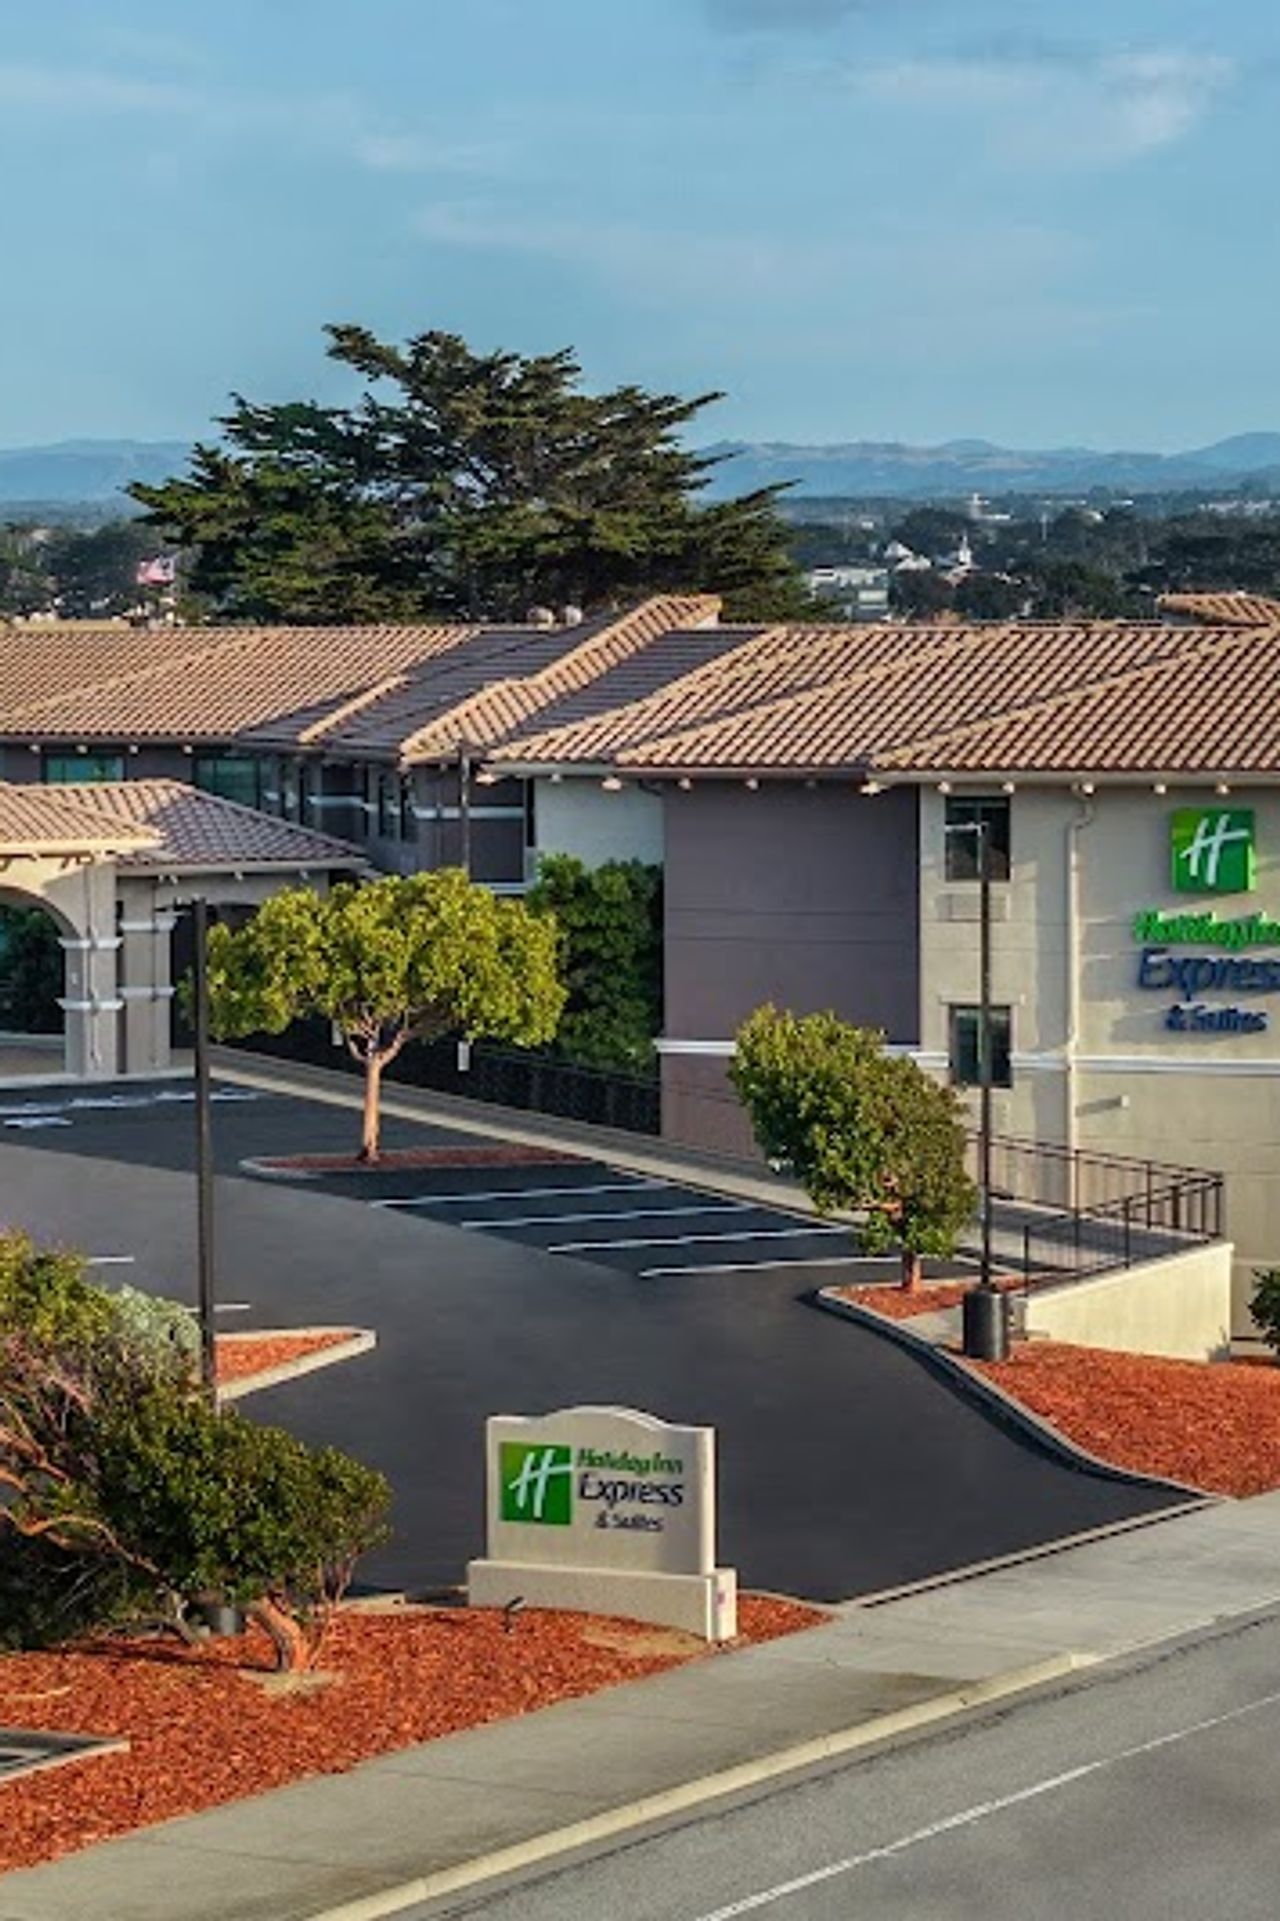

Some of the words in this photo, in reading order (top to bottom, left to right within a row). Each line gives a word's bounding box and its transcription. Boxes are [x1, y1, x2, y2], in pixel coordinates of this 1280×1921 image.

[1251, 911, 1280, 945] In
[1140, 947, 1280, 1002] Expres
[1165, 1004, 1187, 1032] &
[1190, 1005, 1268, 1034] Suites
[578, 1448, 650, 1476] Holiday
[652, 1451, 683, 1474] Inn
[580, 1473, 683, 1508] Express
[595, 1510, 608, 1529] &
[612, 1512, 664, 1533] Suites
